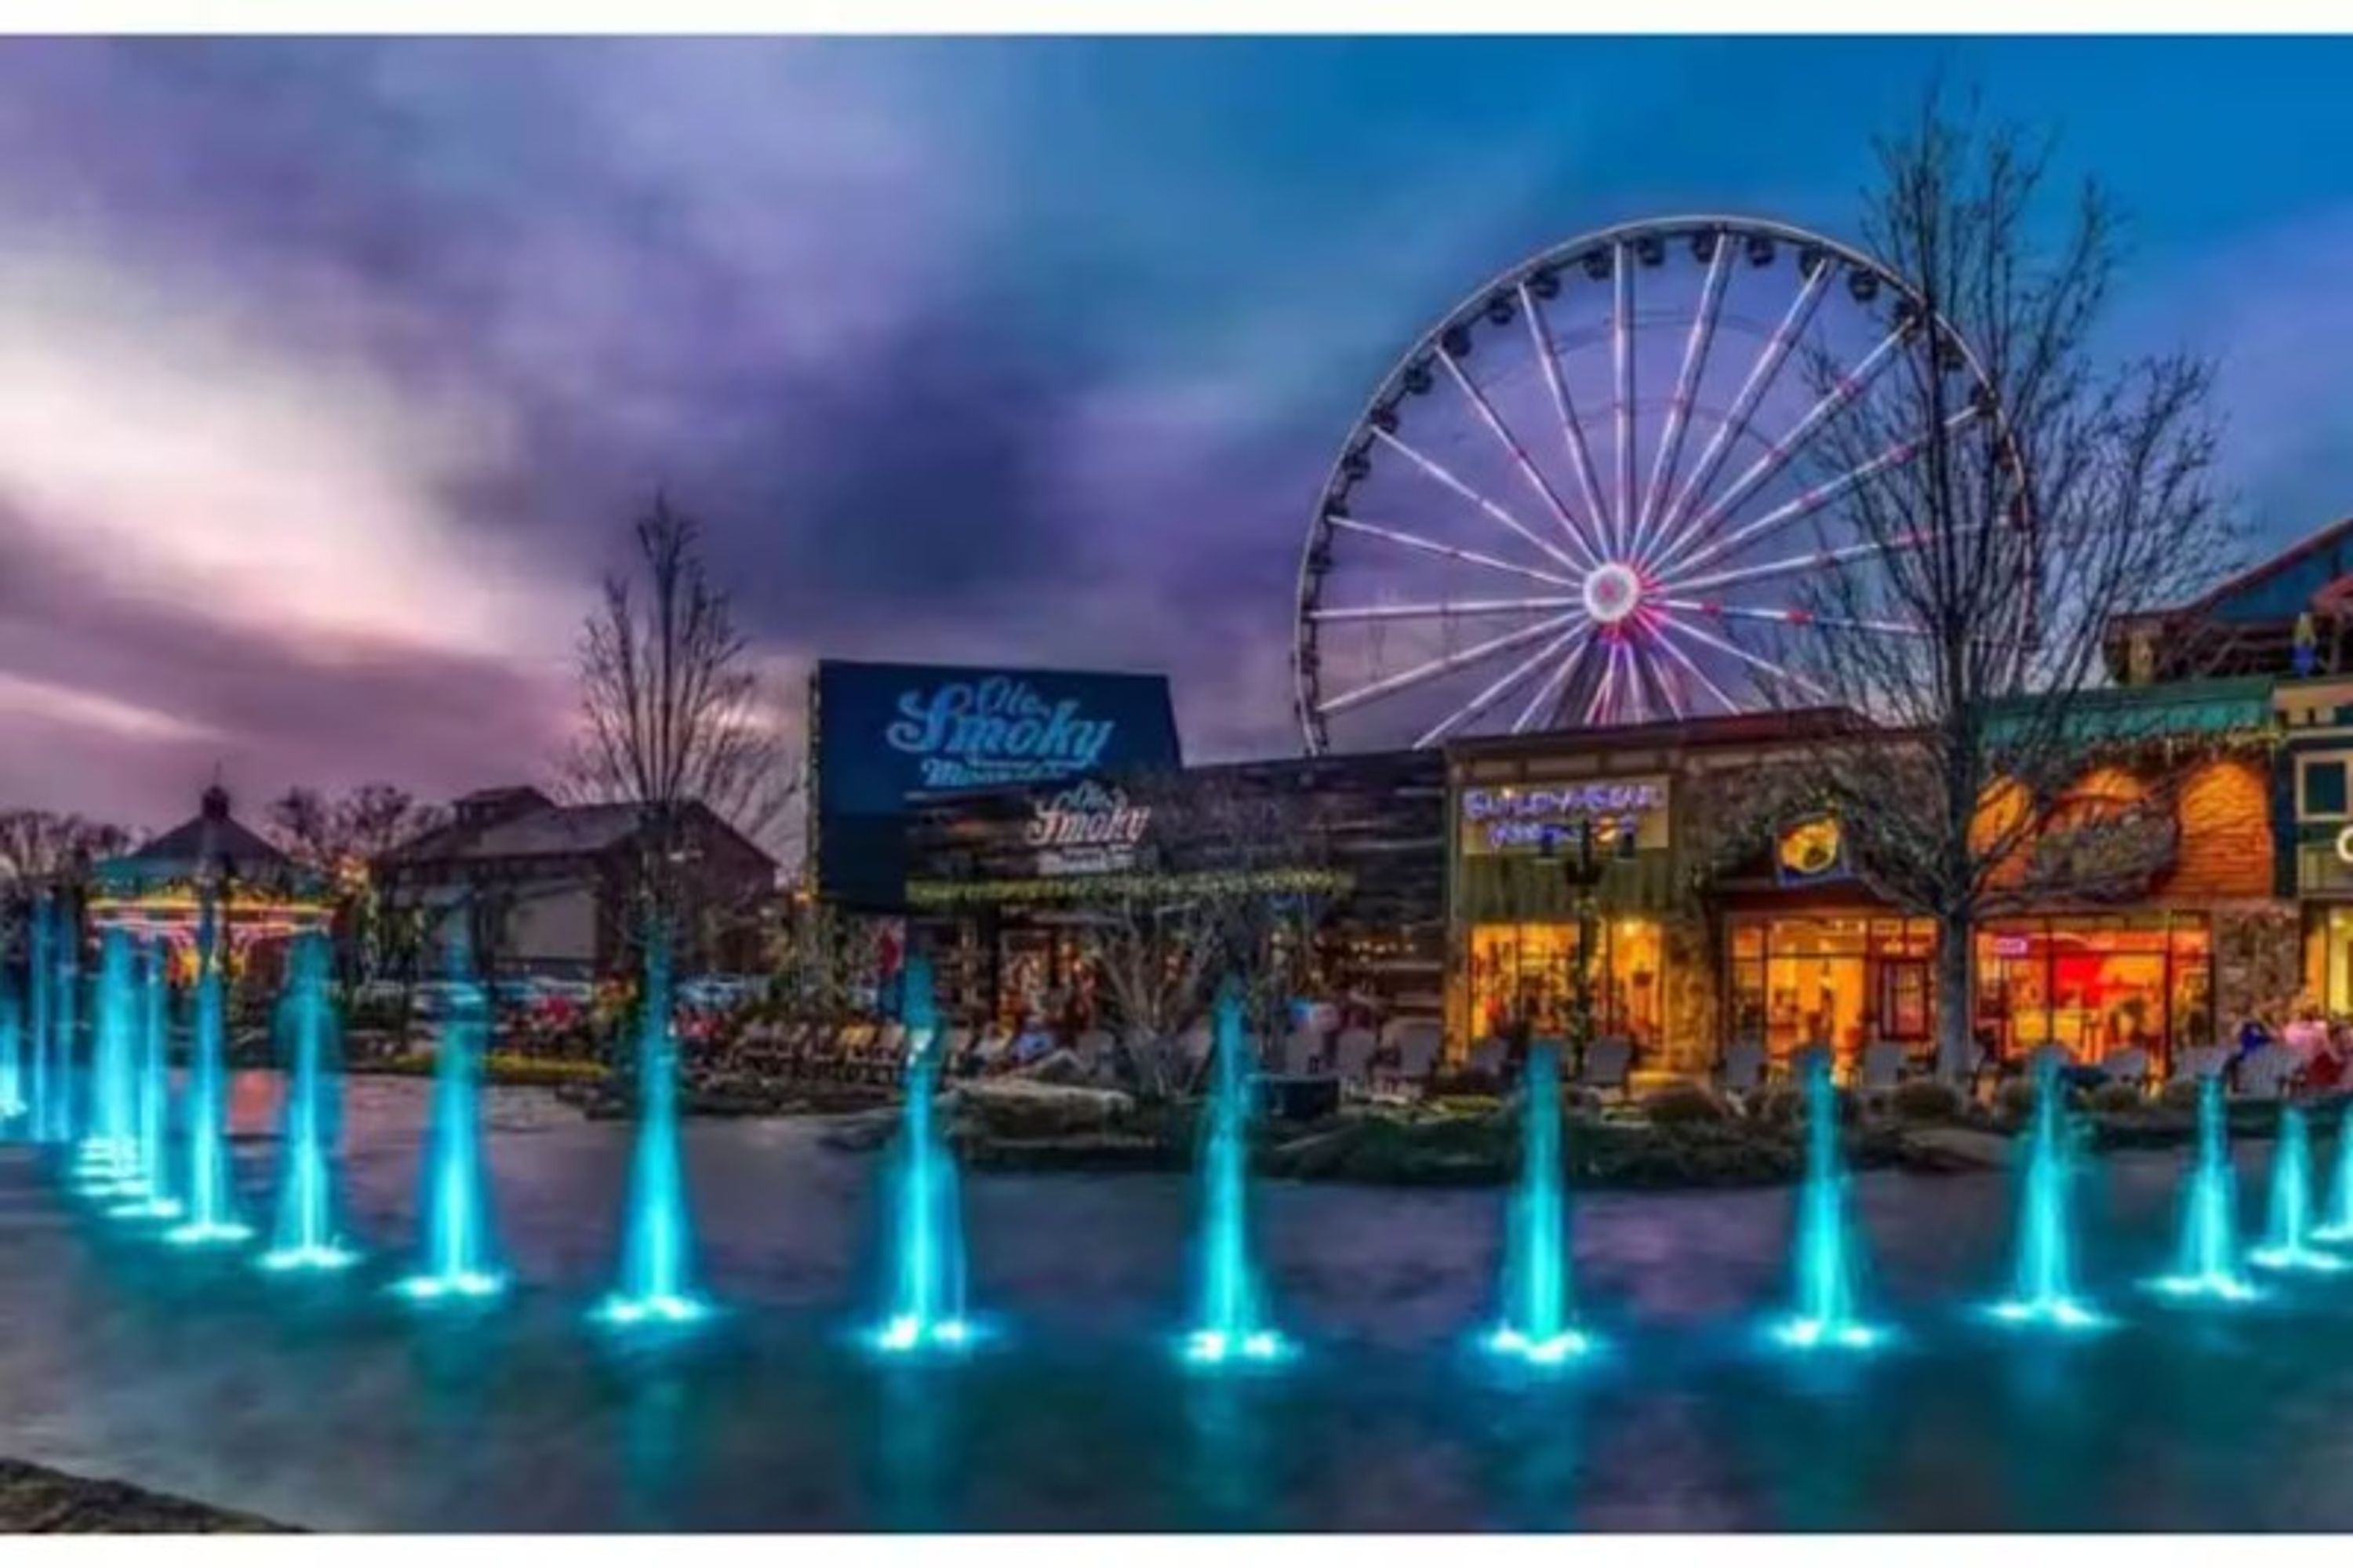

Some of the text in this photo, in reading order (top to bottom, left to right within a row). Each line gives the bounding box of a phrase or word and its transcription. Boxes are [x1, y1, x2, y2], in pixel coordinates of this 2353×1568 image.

[976, 675, 1051, 717] Ole
[886, 682, 1116, 770] Smoky
[1024, 789, 1151, 846] Smoky
